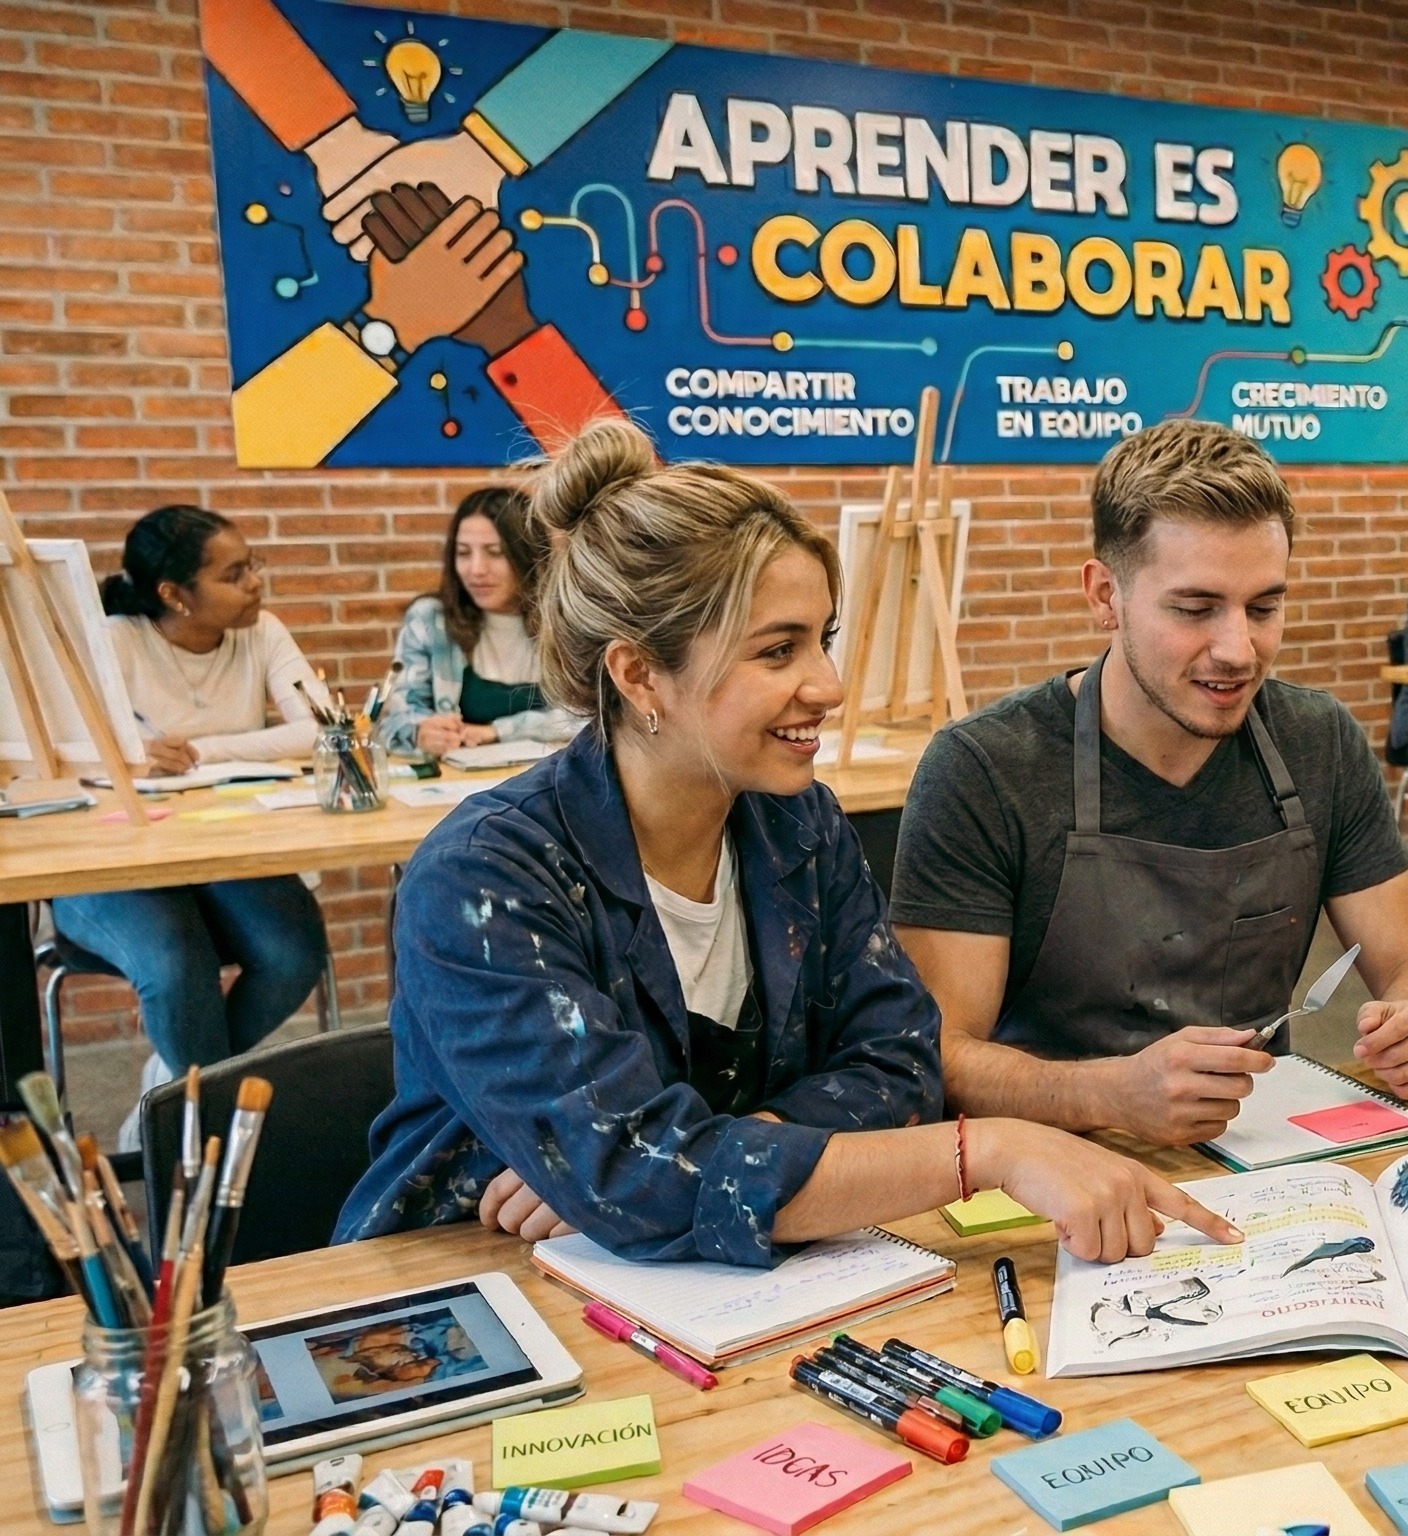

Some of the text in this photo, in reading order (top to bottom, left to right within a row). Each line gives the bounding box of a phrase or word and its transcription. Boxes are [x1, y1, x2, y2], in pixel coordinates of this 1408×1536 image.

[646, 91, 1239, 226] APRENDER ES
[751, 215, 1292, 324] COLABORAR
[665, 367, 857, 400] COMPARTIR
[996, 376, 1128, 405] TRABAJO
[1231, 381, 1388, 410] CRECIMIENTO
[667, 405, 915, 437] CONOCIMIENTO
[997, 409, 1143, 439] EN EQUIPO
[1232, 412, 1321, 441] MUTUO
[1284, 1378, 1392, 1414] EQUIPO
[502, 1422, 652, 1459] INNOVACIÓN
[1041, 1446, 1154, 1489] EQUIPO
